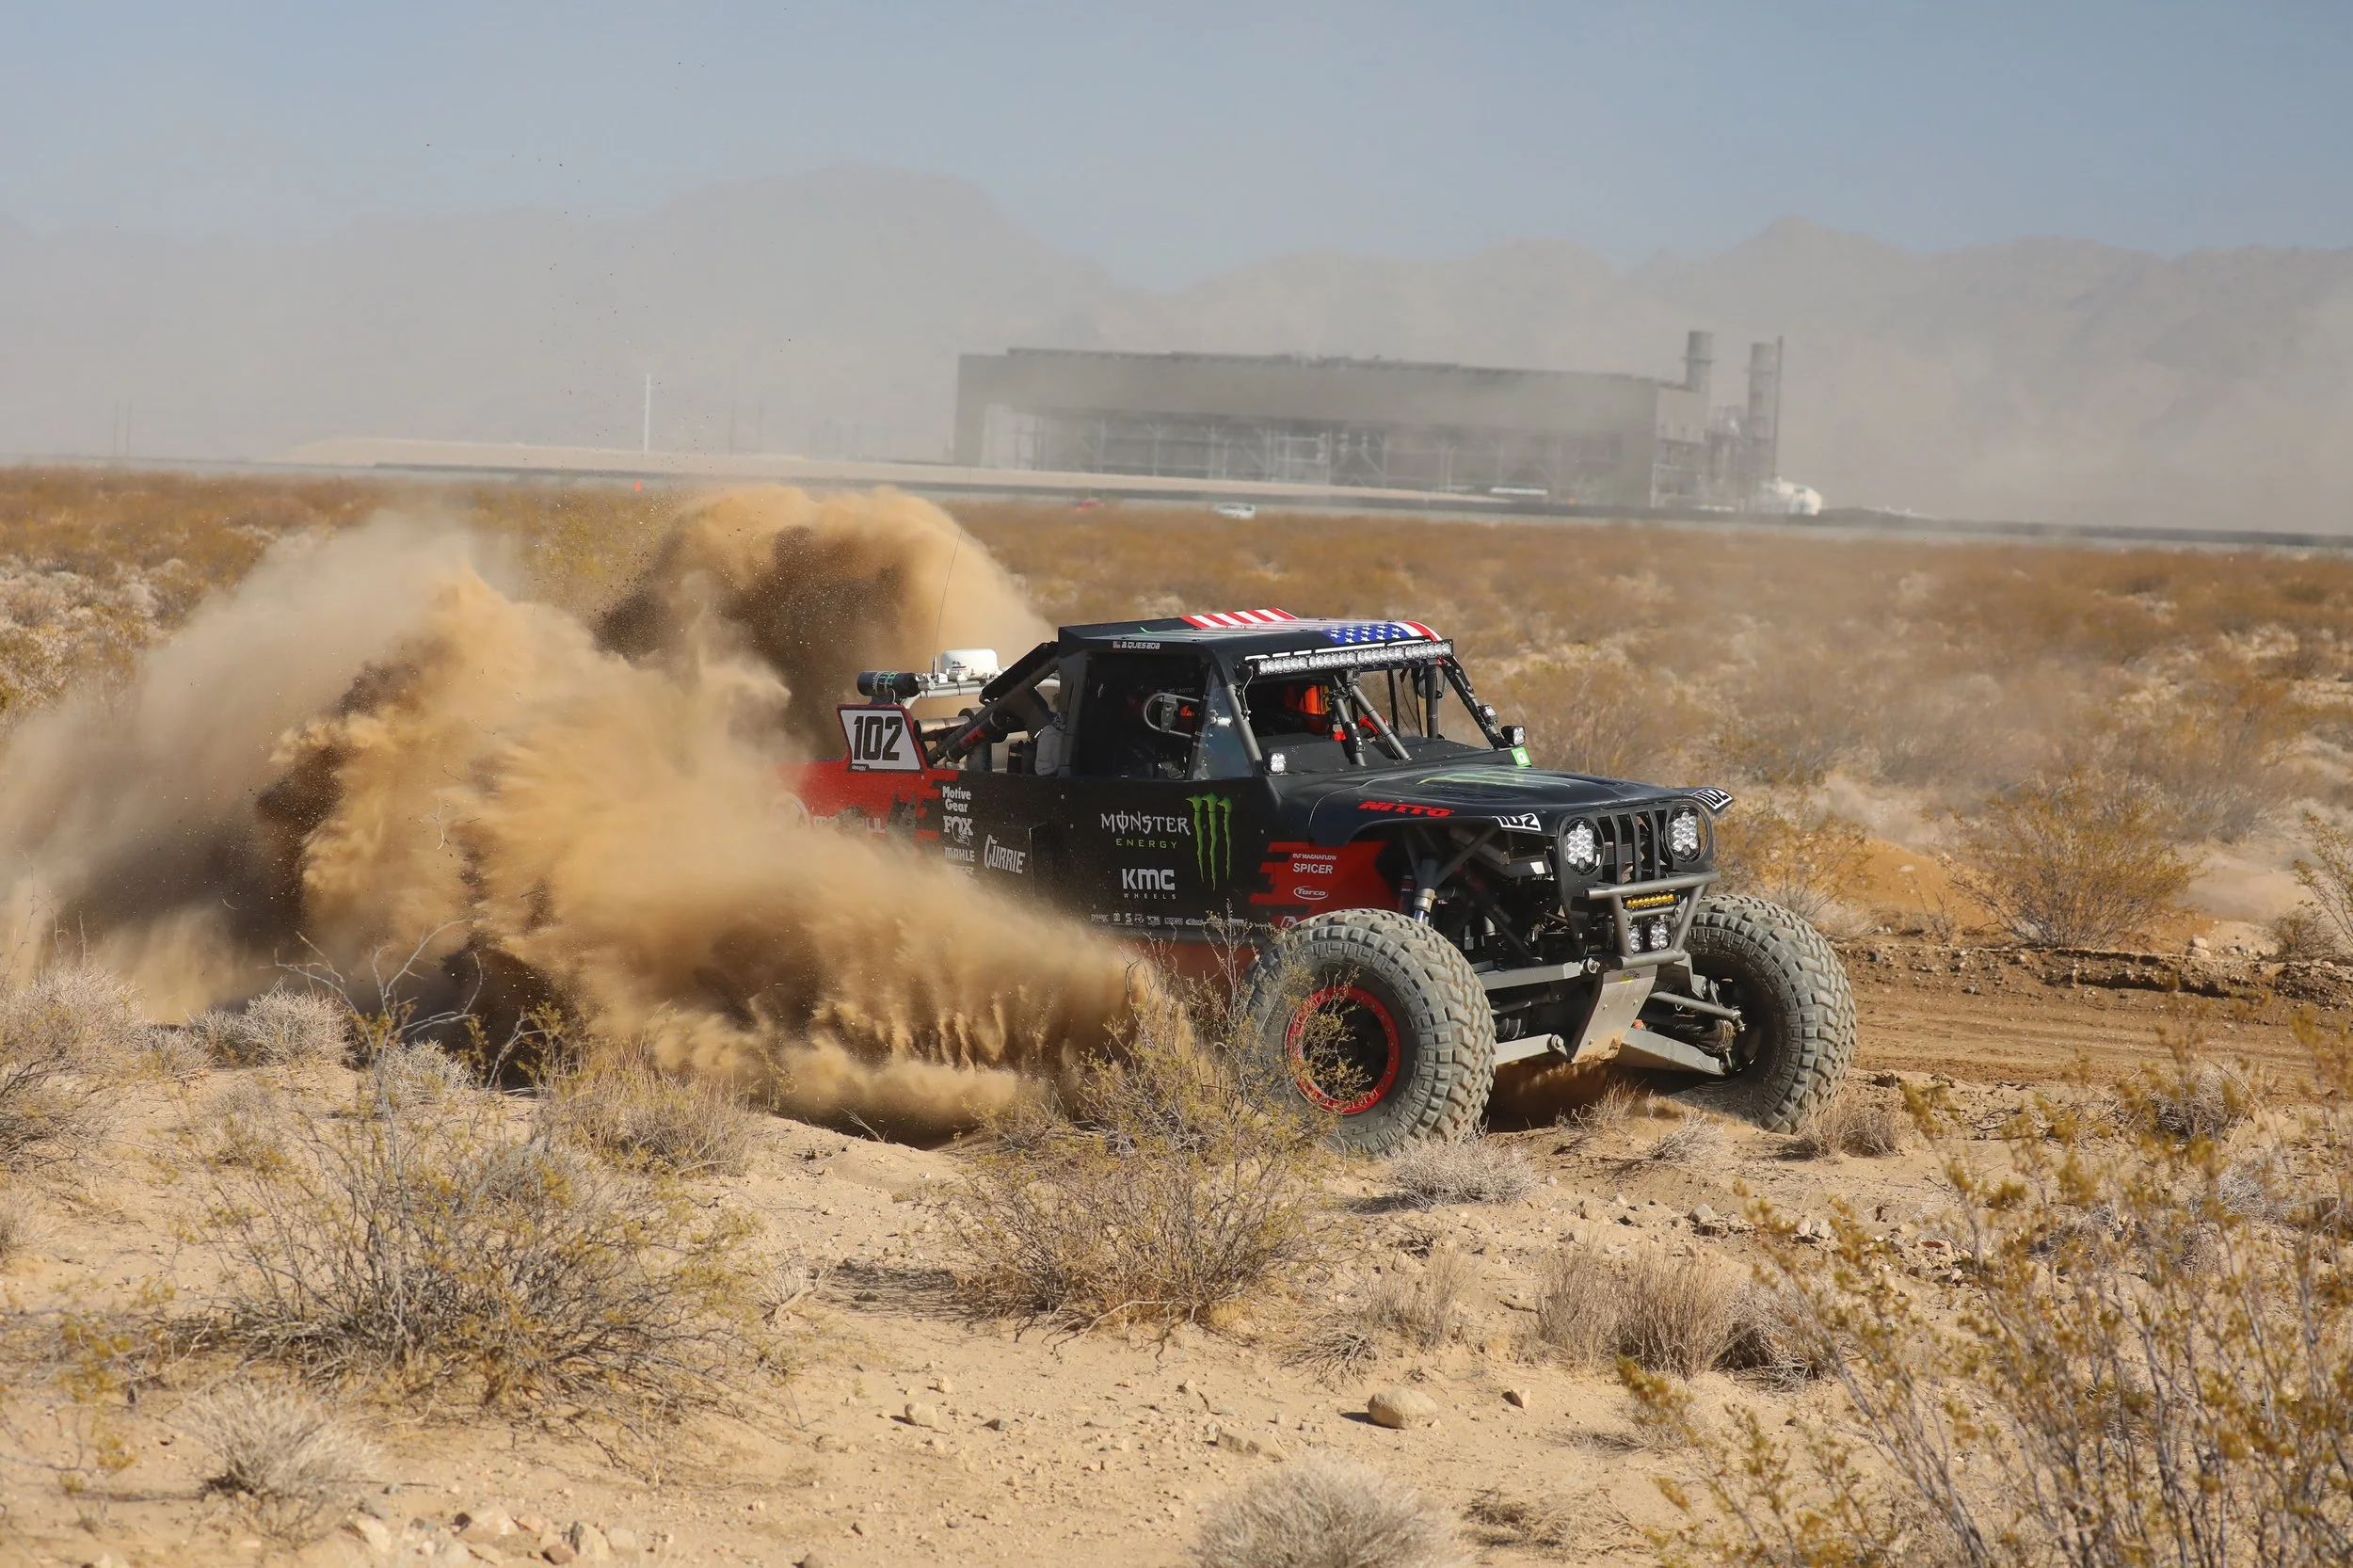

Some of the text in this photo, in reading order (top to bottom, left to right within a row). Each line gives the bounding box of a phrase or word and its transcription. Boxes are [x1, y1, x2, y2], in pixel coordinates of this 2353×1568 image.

[854, 716, 903, 760] 102
[942, 786, 971, 800] Motive
[945, 799, 968, 812] Gear
[1358, 801, 1451, 818] NITTO
[943, 816, 973, 842] FOX
[1100, 810, 1191, 836] MONSTER
[1116, 839, 1176, 849] ENERGY
[944, 847, 975, 862] MAHLE
[984, 834, 1026, 873] CURRIE
[1292, 862, 1334, 874] SPICER
[1122, 869, 1176, 890] KMC
